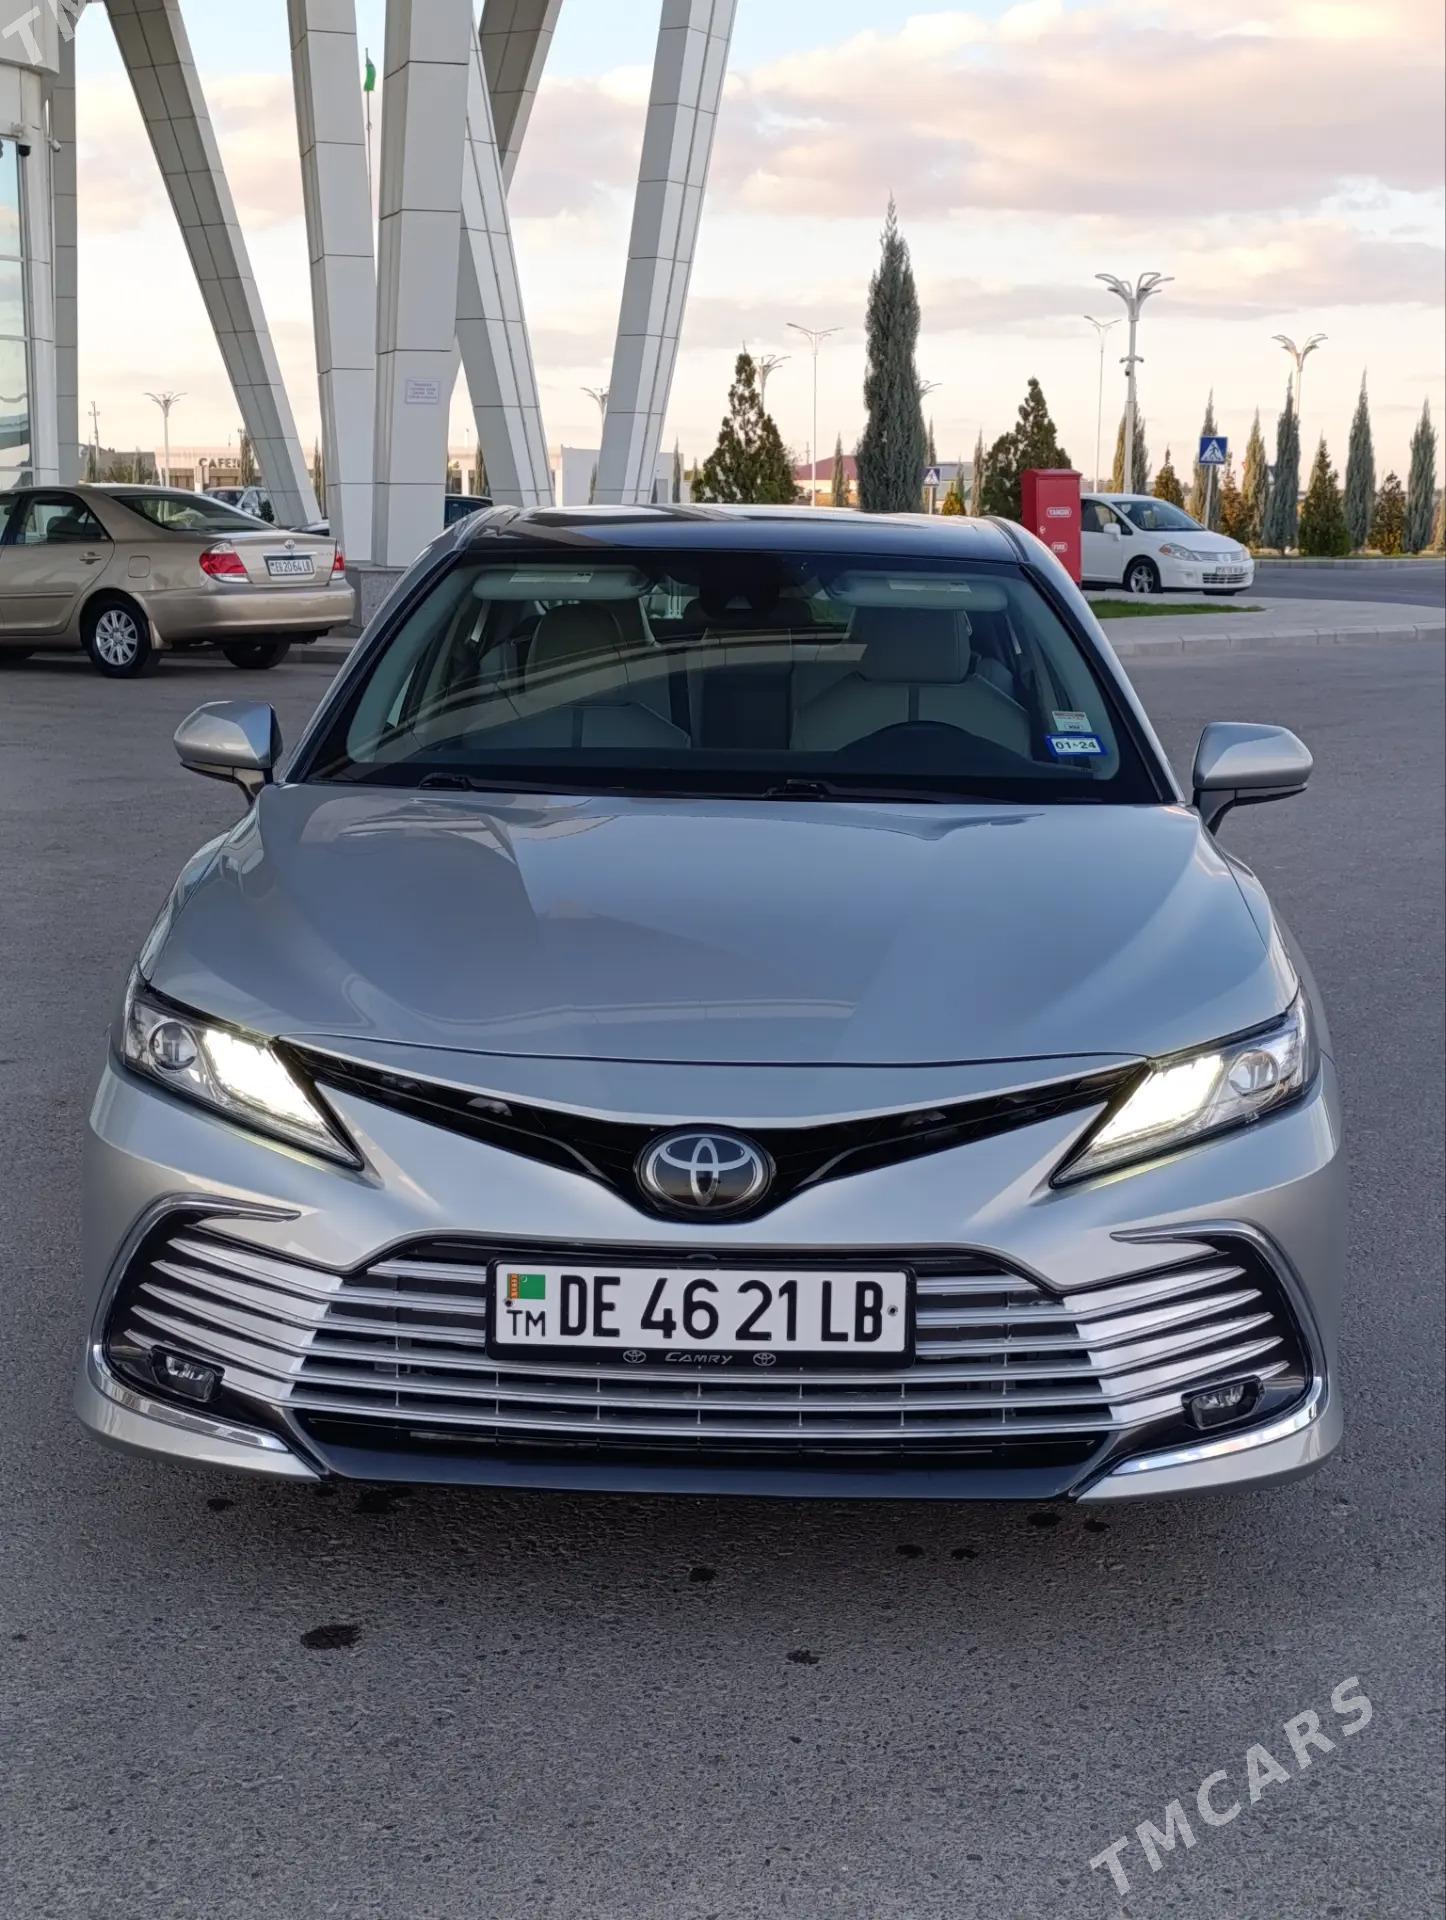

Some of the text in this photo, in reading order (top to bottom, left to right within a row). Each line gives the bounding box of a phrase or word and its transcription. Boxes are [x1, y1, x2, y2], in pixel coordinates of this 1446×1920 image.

[1055, 741, 1097, 750] 01-24
[559, 1274, 621, 1337] DE
[821, 1280, 883, 1342] LB
[506, 1309, 546, 1337] TM
[664, 1351, 733, 1365] CAMRY
